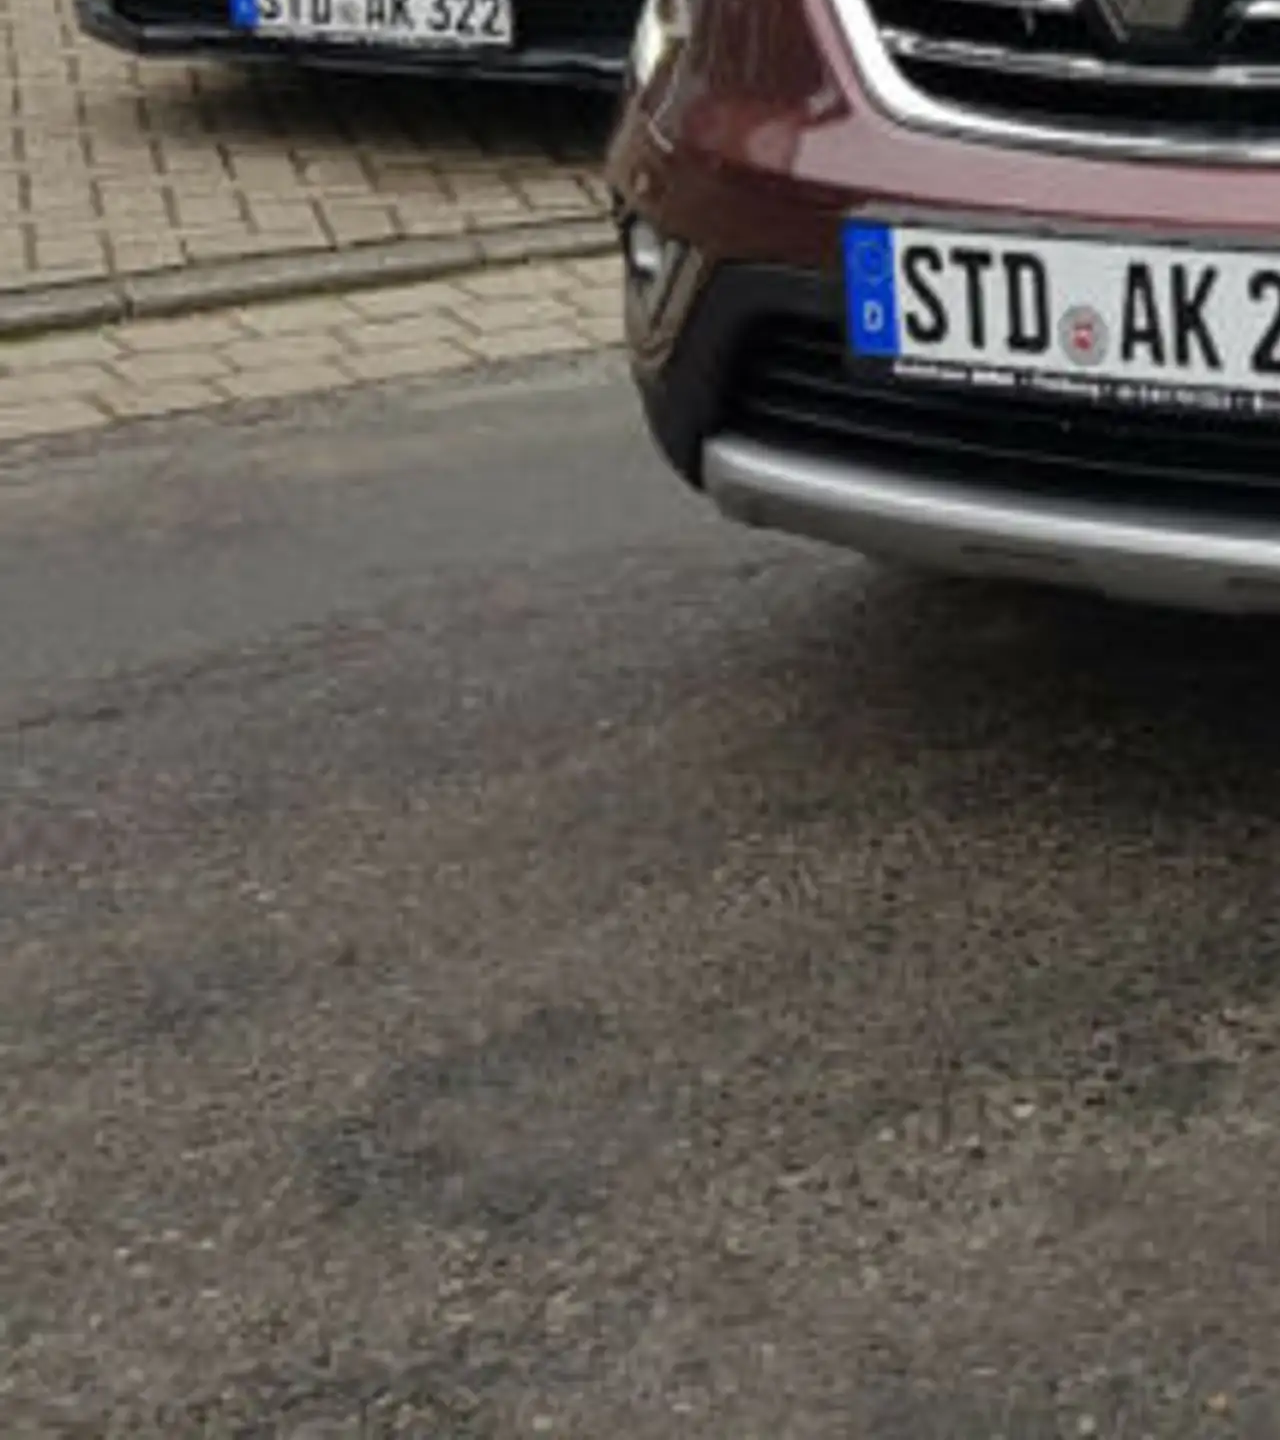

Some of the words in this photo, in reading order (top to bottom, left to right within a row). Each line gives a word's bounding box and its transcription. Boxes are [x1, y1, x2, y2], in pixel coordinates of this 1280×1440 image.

[863, 300, 884, 332] D
[902, 245, 1050, 353] STD
[1119, 263, 1222, 369] AK
